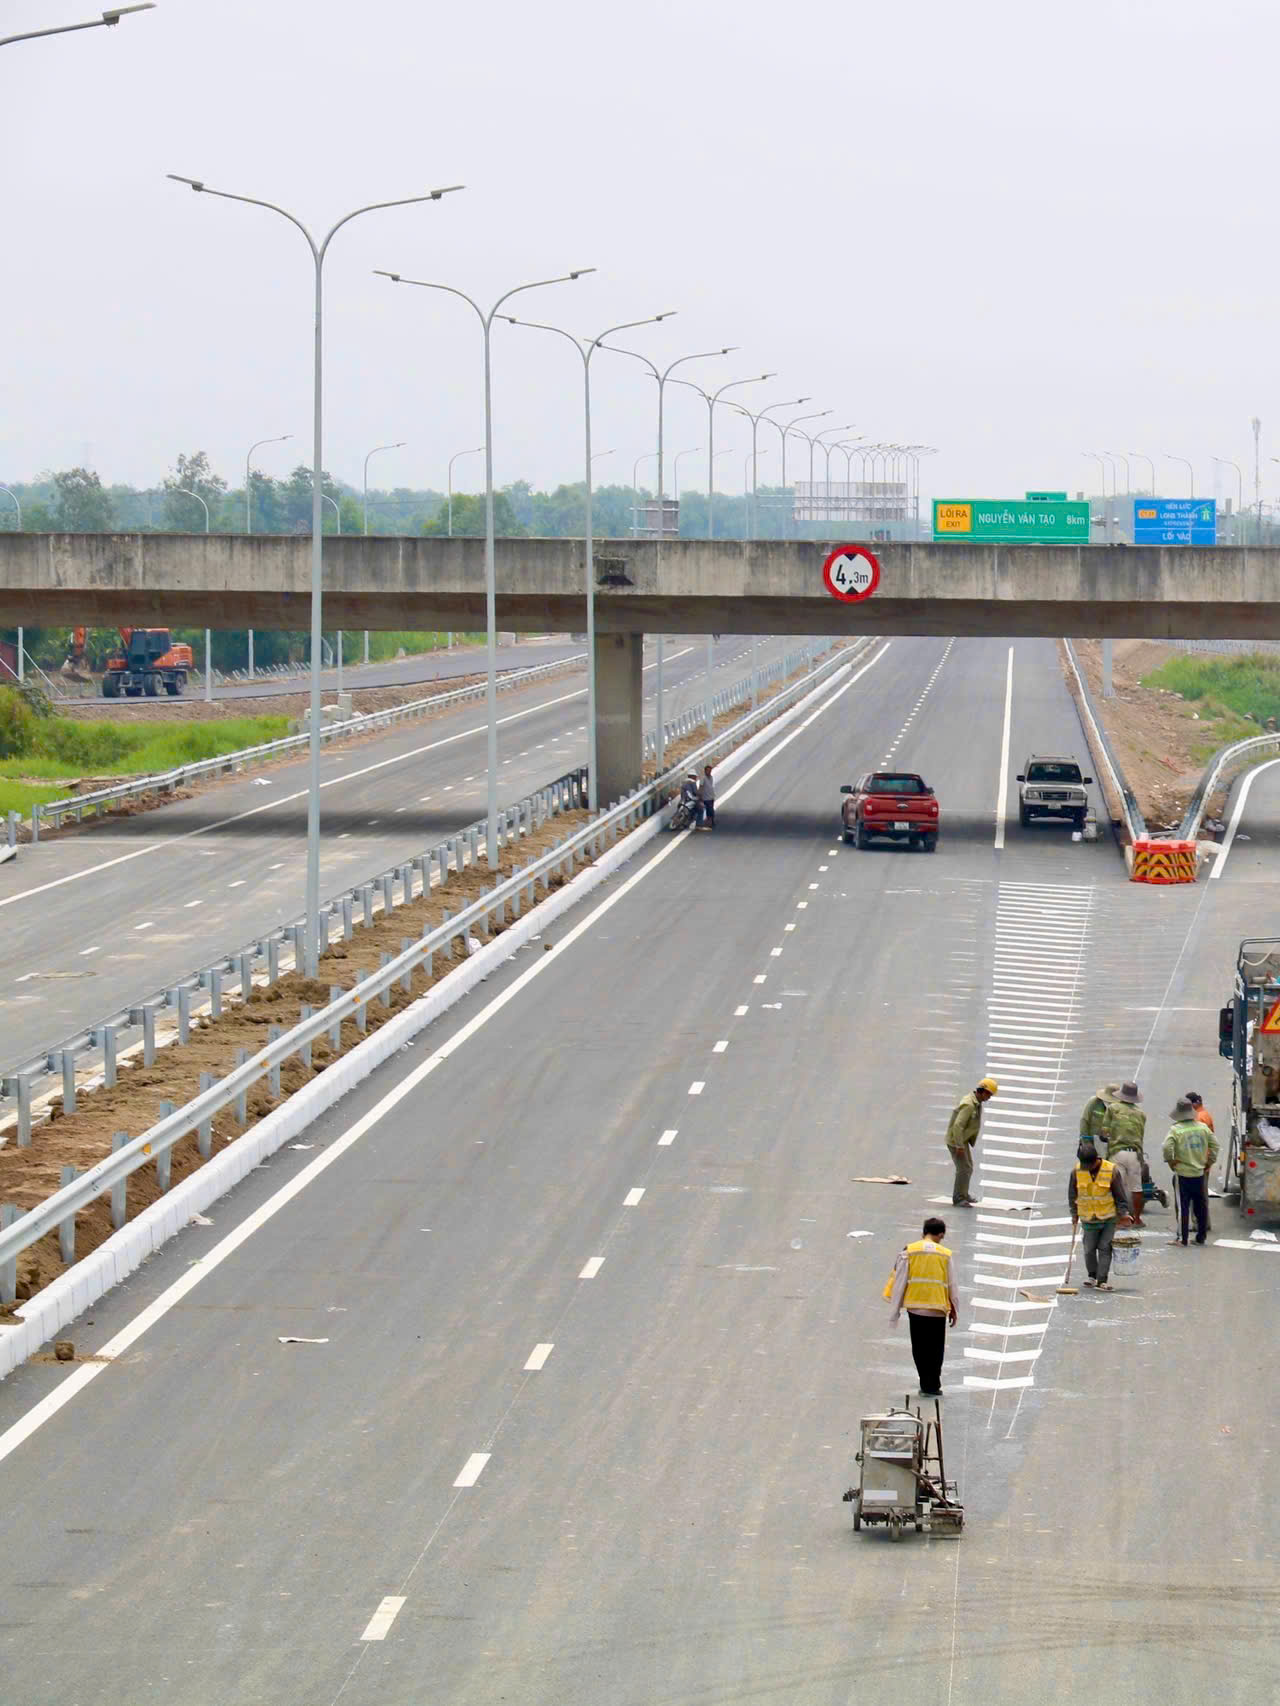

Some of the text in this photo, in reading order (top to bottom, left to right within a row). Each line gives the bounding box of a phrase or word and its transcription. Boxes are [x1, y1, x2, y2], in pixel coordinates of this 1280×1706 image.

[955, 509, 968, 518] RA
[945, 520, 961, 528] EXIT
[1038, 513, 1056, 527] TẠO
[1066, 514, 1086, 525] 8km
